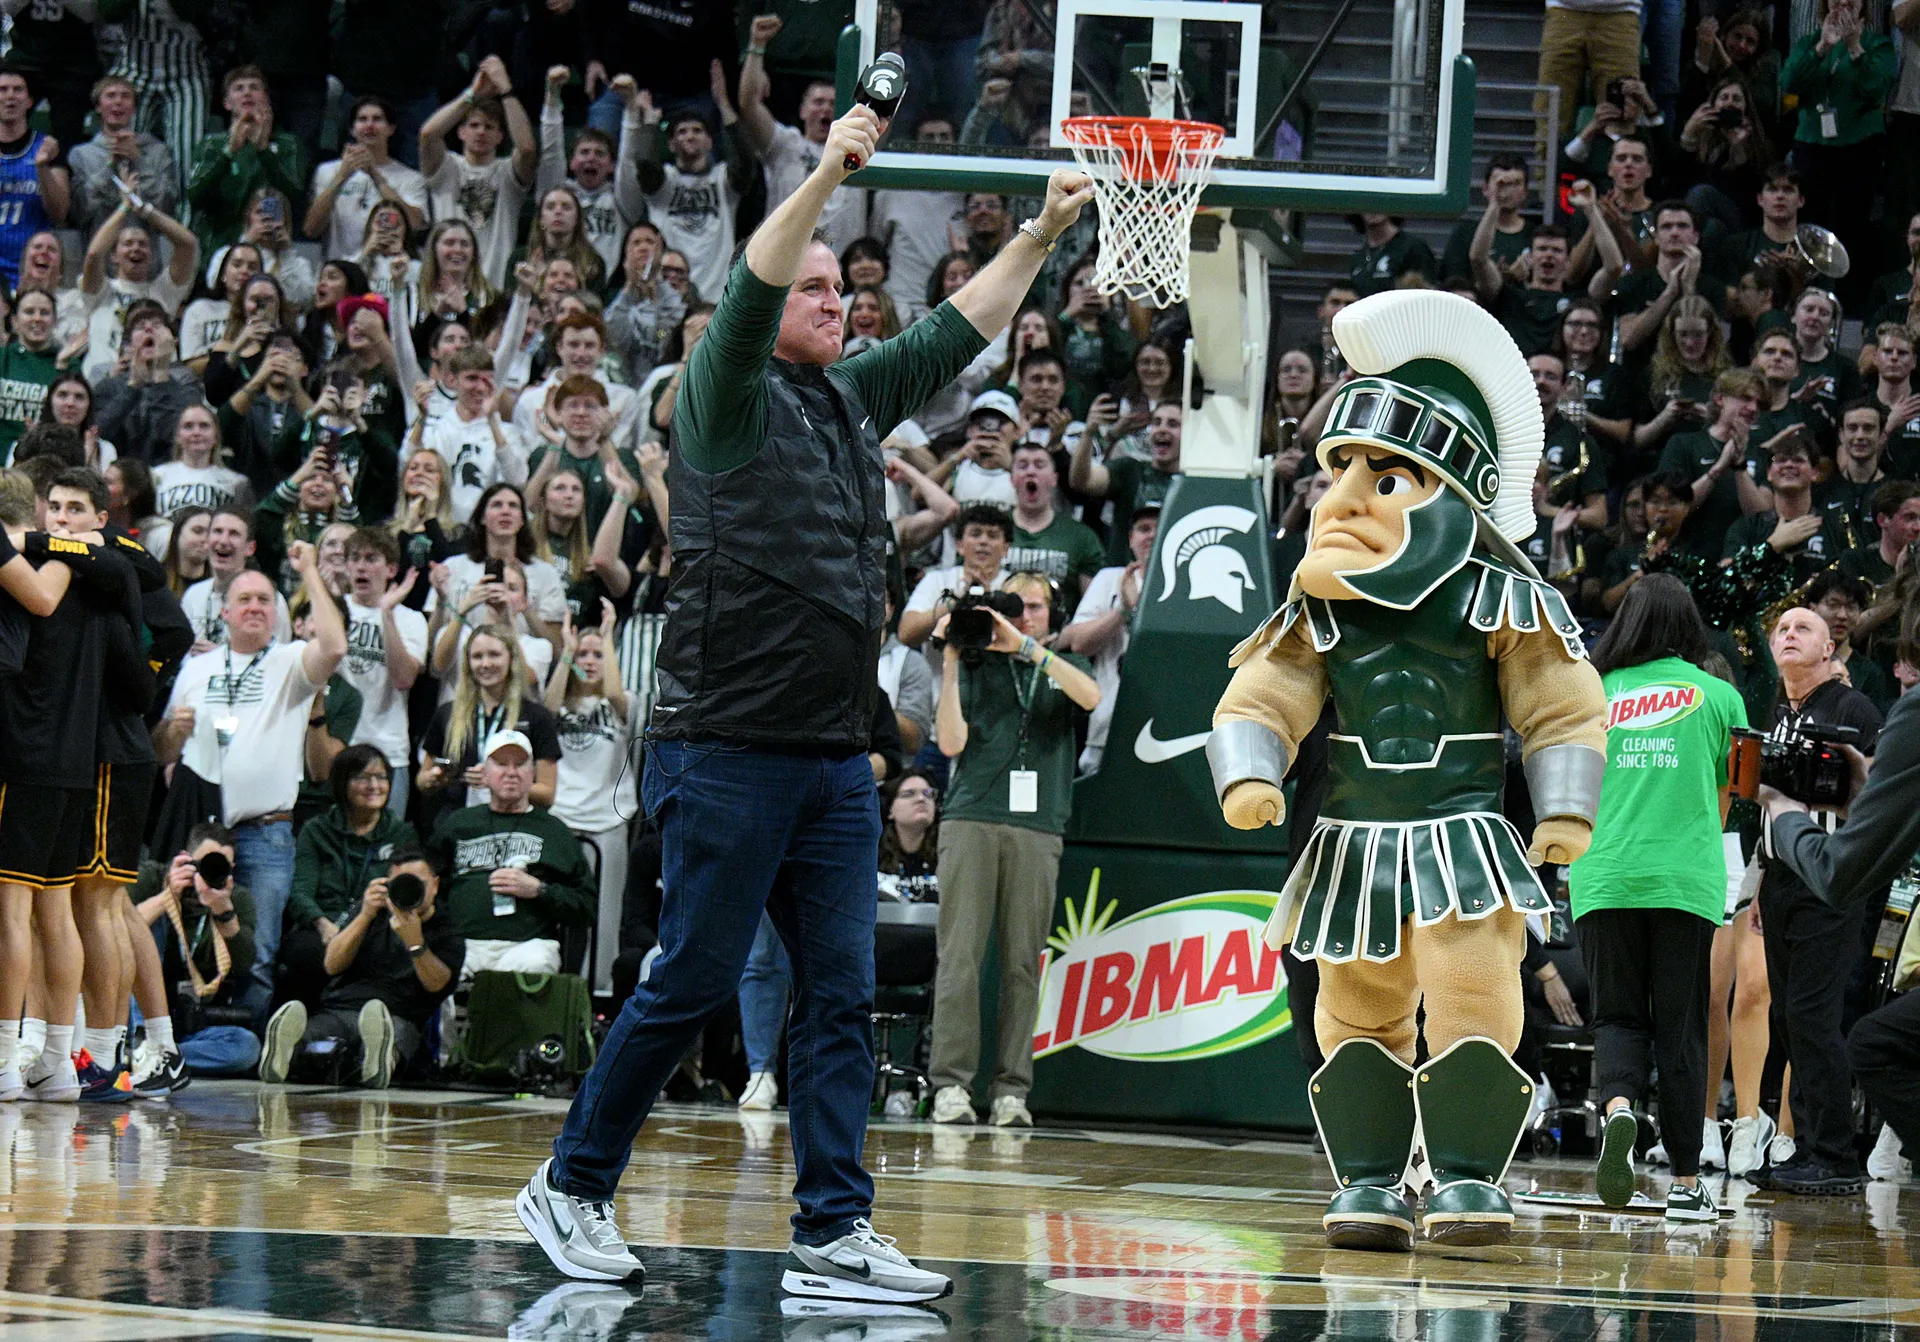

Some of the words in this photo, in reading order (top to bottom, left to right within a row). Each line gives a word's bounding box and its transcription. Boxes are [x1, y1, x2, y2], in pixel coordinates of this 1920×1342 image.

[49, 537, 90, 555] IOWA
[1604, 687, 1695, 731] IBMAN
[1622, 737, 1675, 753] CLEANING
[1616, 754, 1648, 769] SINCE
[1652, 752, 1679, 768] 1896
